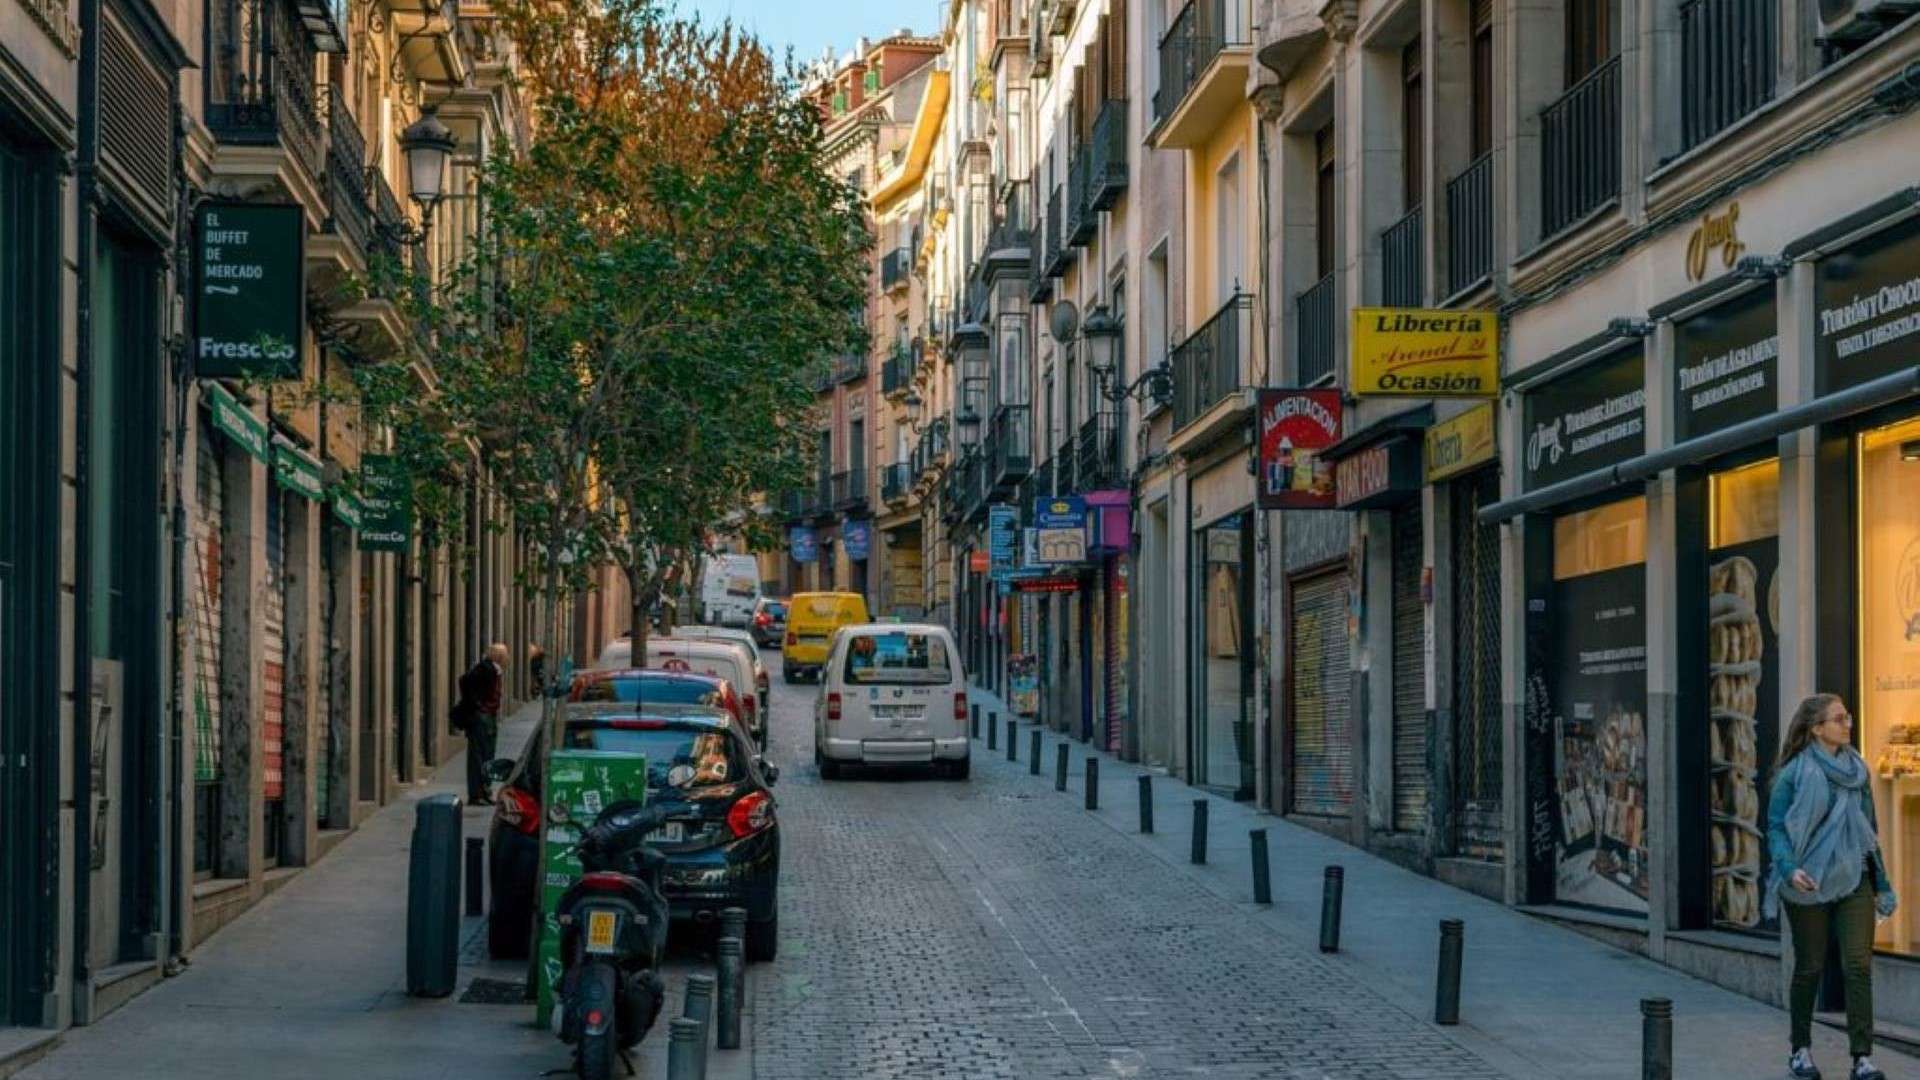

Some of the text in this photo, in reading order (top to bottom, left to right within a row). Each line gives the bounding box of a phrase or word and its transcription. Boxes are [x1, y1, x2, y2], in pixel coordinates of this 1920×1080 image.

[206, 213, 220, 227] EL
[206, 231, 249, 245] BUFFET
[206, 248, 222, 262] DE
[206, 264, 263, 279] MERCADO
[1376, 313, 1482, 333] Librería
[1378, 371, 1482, 391] Ocasión
